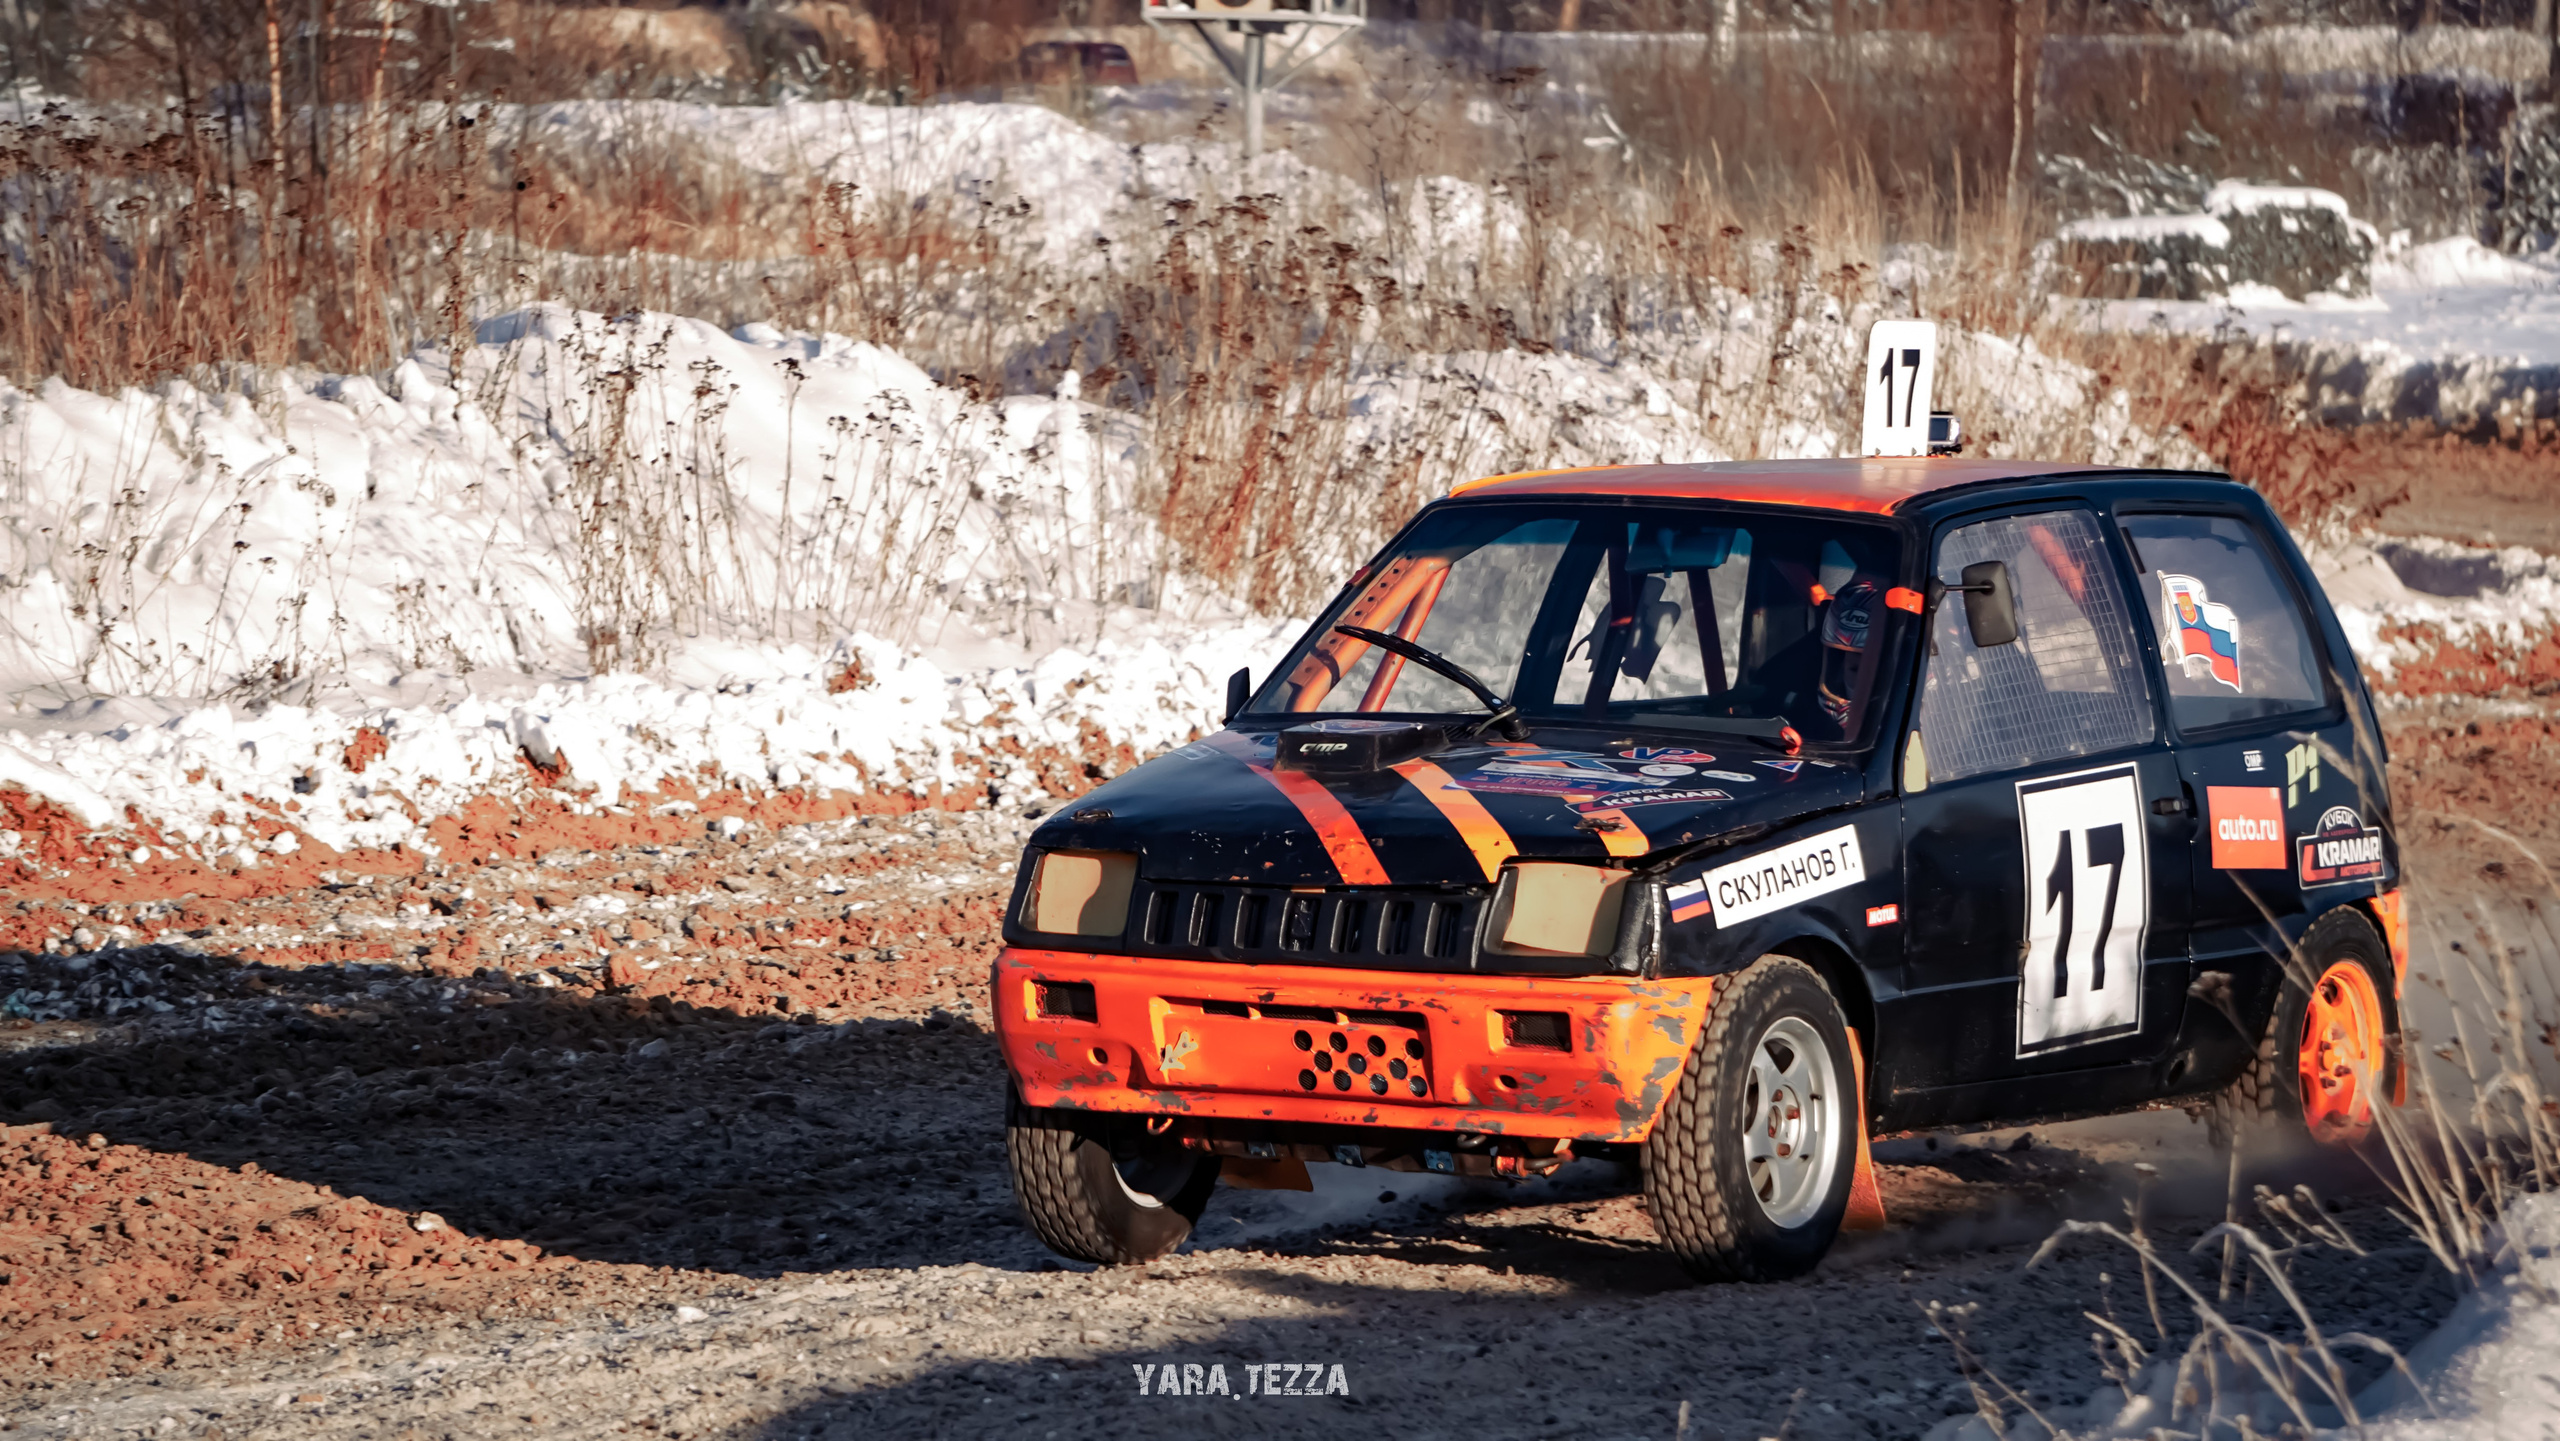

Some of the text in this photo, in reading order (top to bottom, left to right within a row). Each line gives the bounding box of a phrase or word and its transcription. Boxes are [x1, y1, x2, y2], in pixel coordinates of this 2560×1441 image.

[1879, 347, 1921, 428] 17
[1601, 790, 1723, 806] KRAMAR
[2218, 815, 2279, 841] auto.ru
[2324, 810, 2355, 831] КУБОК
[2317, 836, 2380, 868] KRAMAR
[1718, 842, 1856, 908] СКУЛАНОВ Г.
[1868, 907, 1897, 924] MOTUL
[2045, 822, 2125, 999] 17
